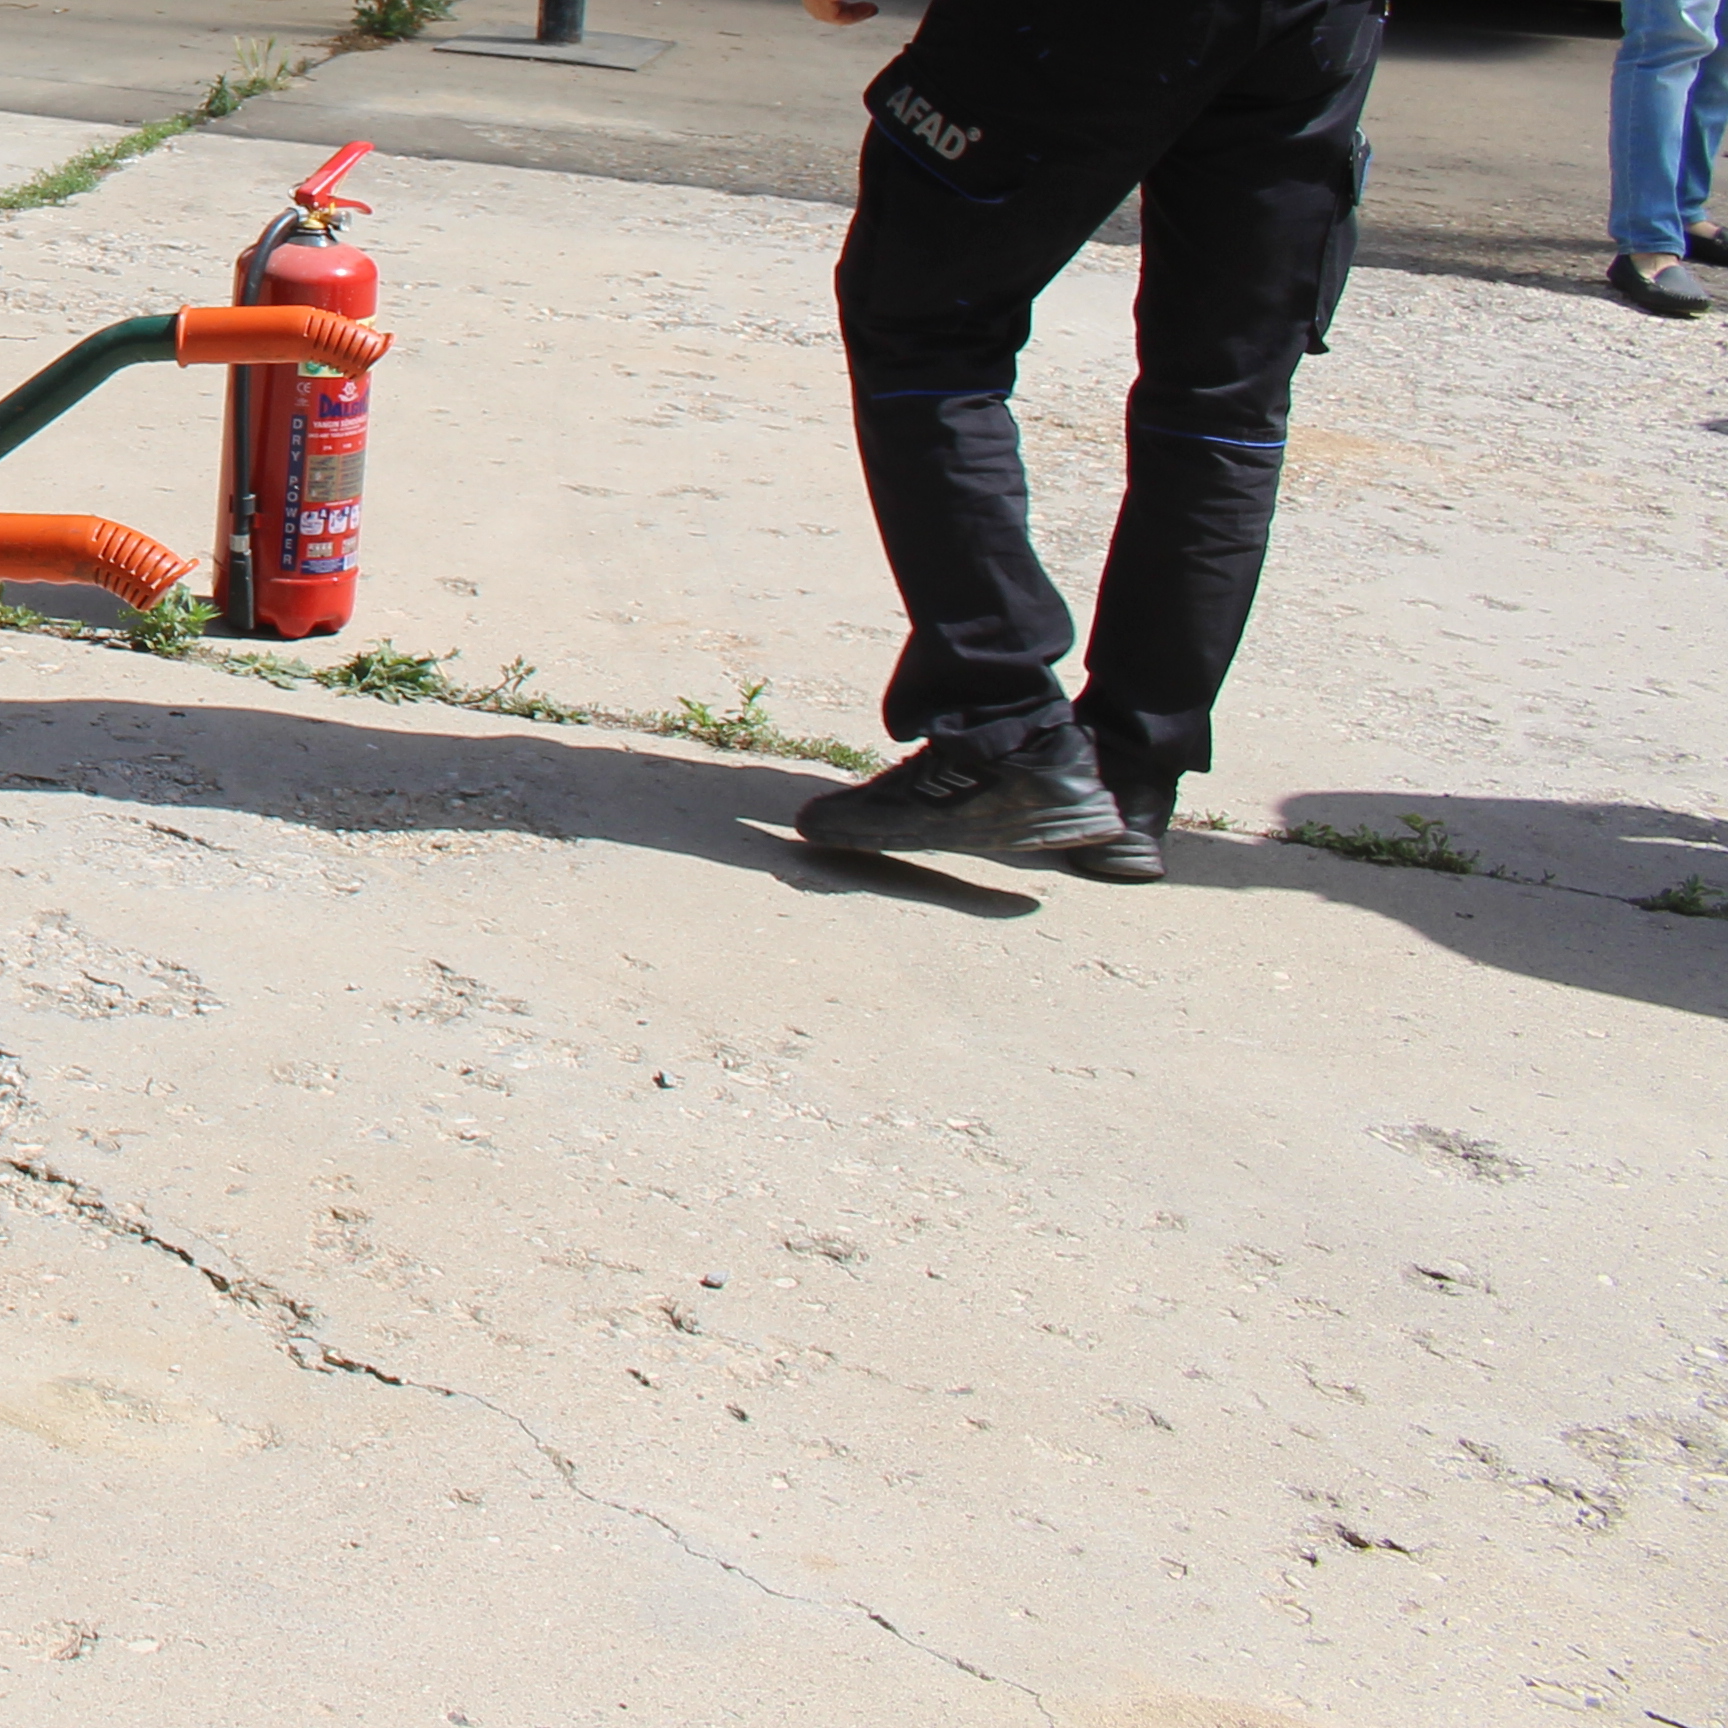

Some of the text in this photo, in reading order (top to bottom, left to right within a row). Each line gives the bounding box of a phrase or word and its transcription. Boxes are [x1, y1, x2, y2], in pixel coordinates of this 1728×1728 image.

[886, 84, 967, 161] AFAD
[291, 417, 304, 462] DRY
[282, 475, 299, 566] POWDER
